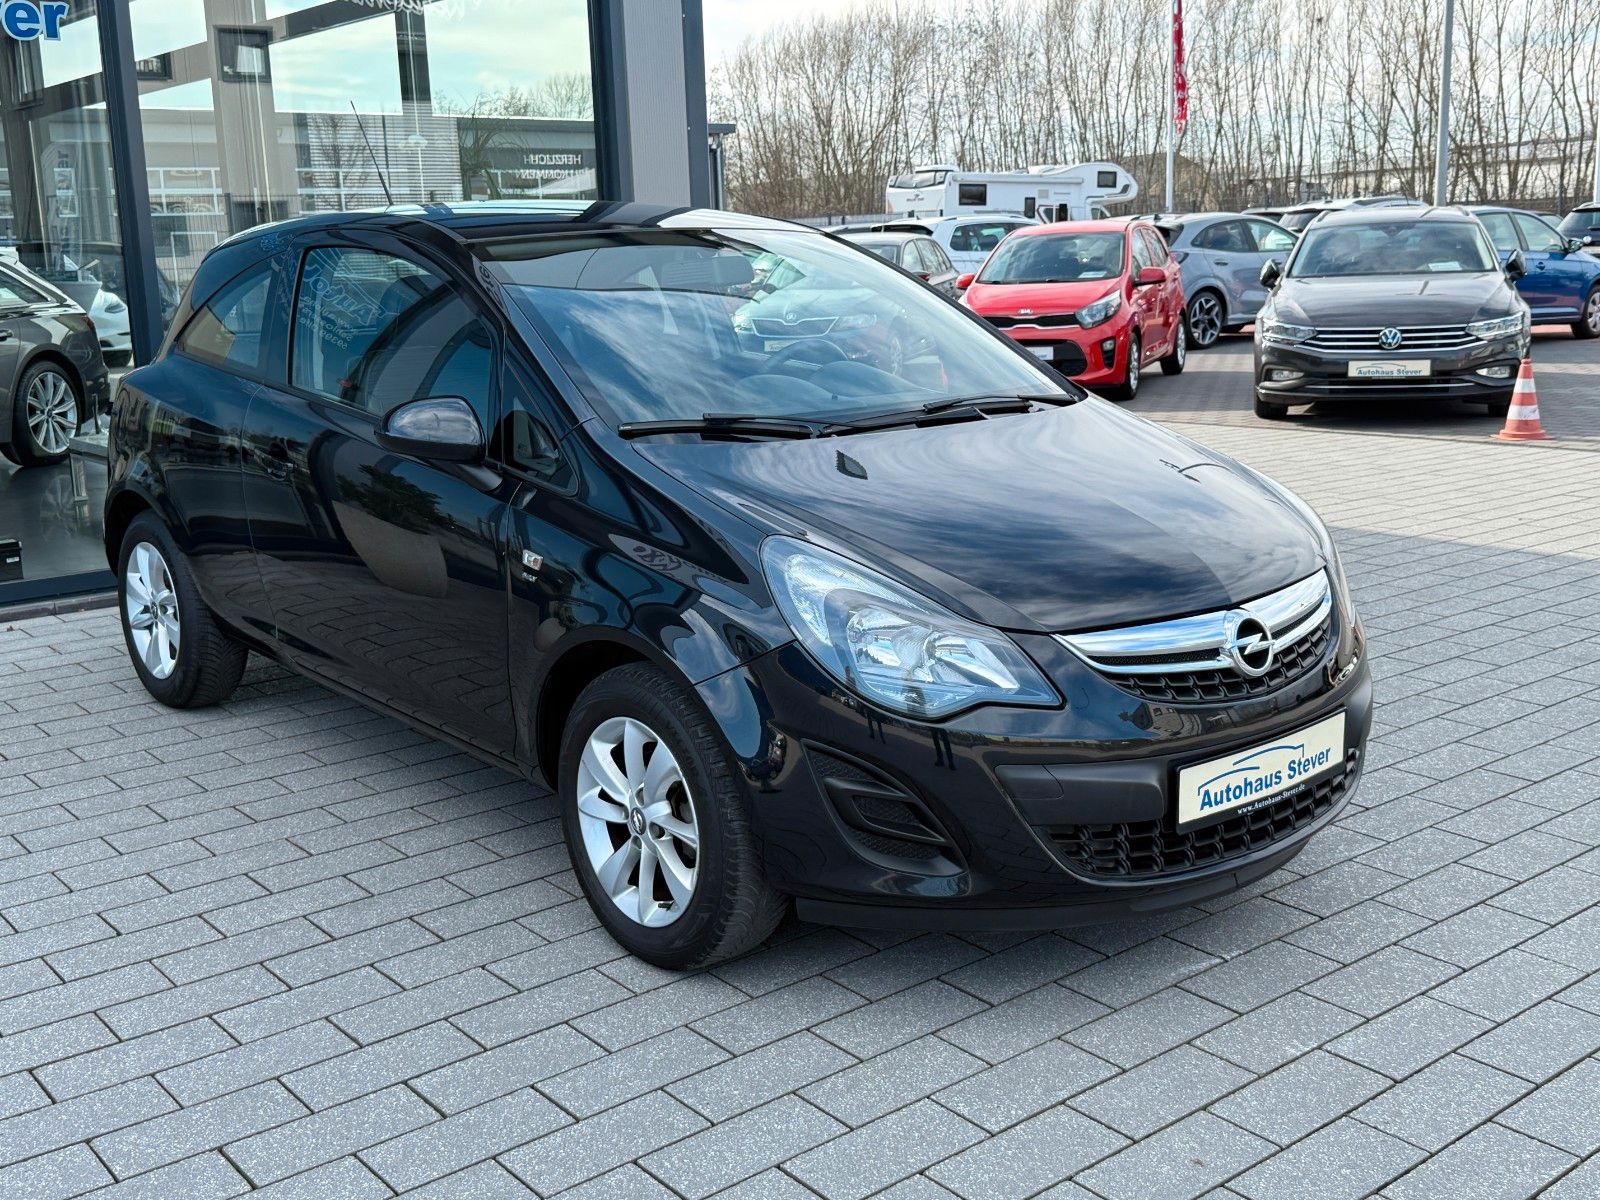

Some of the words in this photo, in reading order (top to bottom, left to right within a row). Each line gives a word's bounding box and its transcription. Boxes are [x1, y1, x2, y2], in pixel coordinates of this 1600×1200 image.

[0, 0, 69, 41] er
[1200, 770, 1282, 811] Autohaus
[1288, 747, 1331, 779] Stever
[1237, 783, 1306, 814] www.Autohaus-Stever.de
